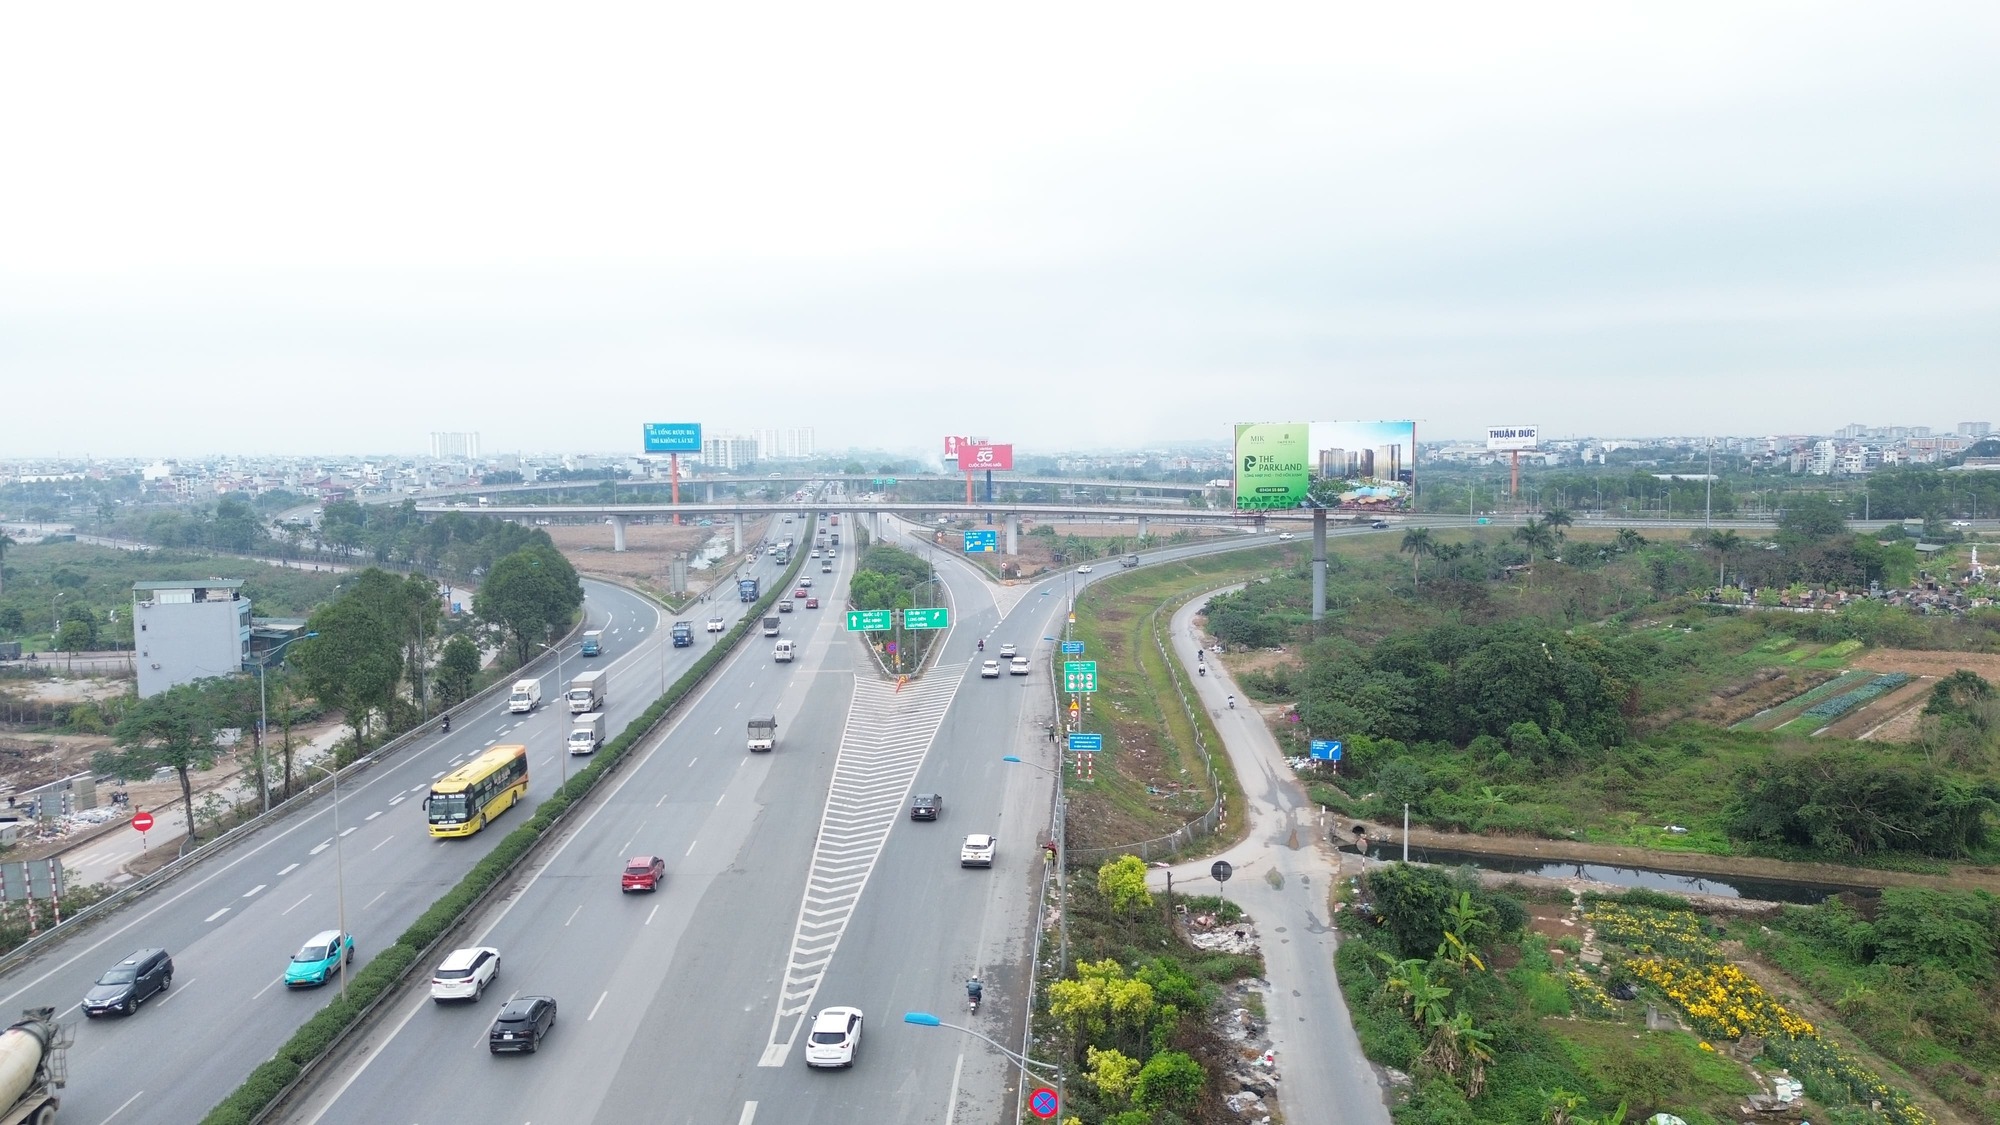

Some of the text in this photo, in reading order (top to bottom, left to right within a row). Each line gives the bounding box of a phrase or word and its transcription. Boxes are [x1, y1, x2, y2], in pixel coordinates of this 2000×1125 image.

[1489, 427, 1535, 439] THUẬN ĐỨC
[976, 451, 993, 462] 5G
[1259, 455, 1274, 463] THE
[1259, 463, 1302, 471] PARKLAND
